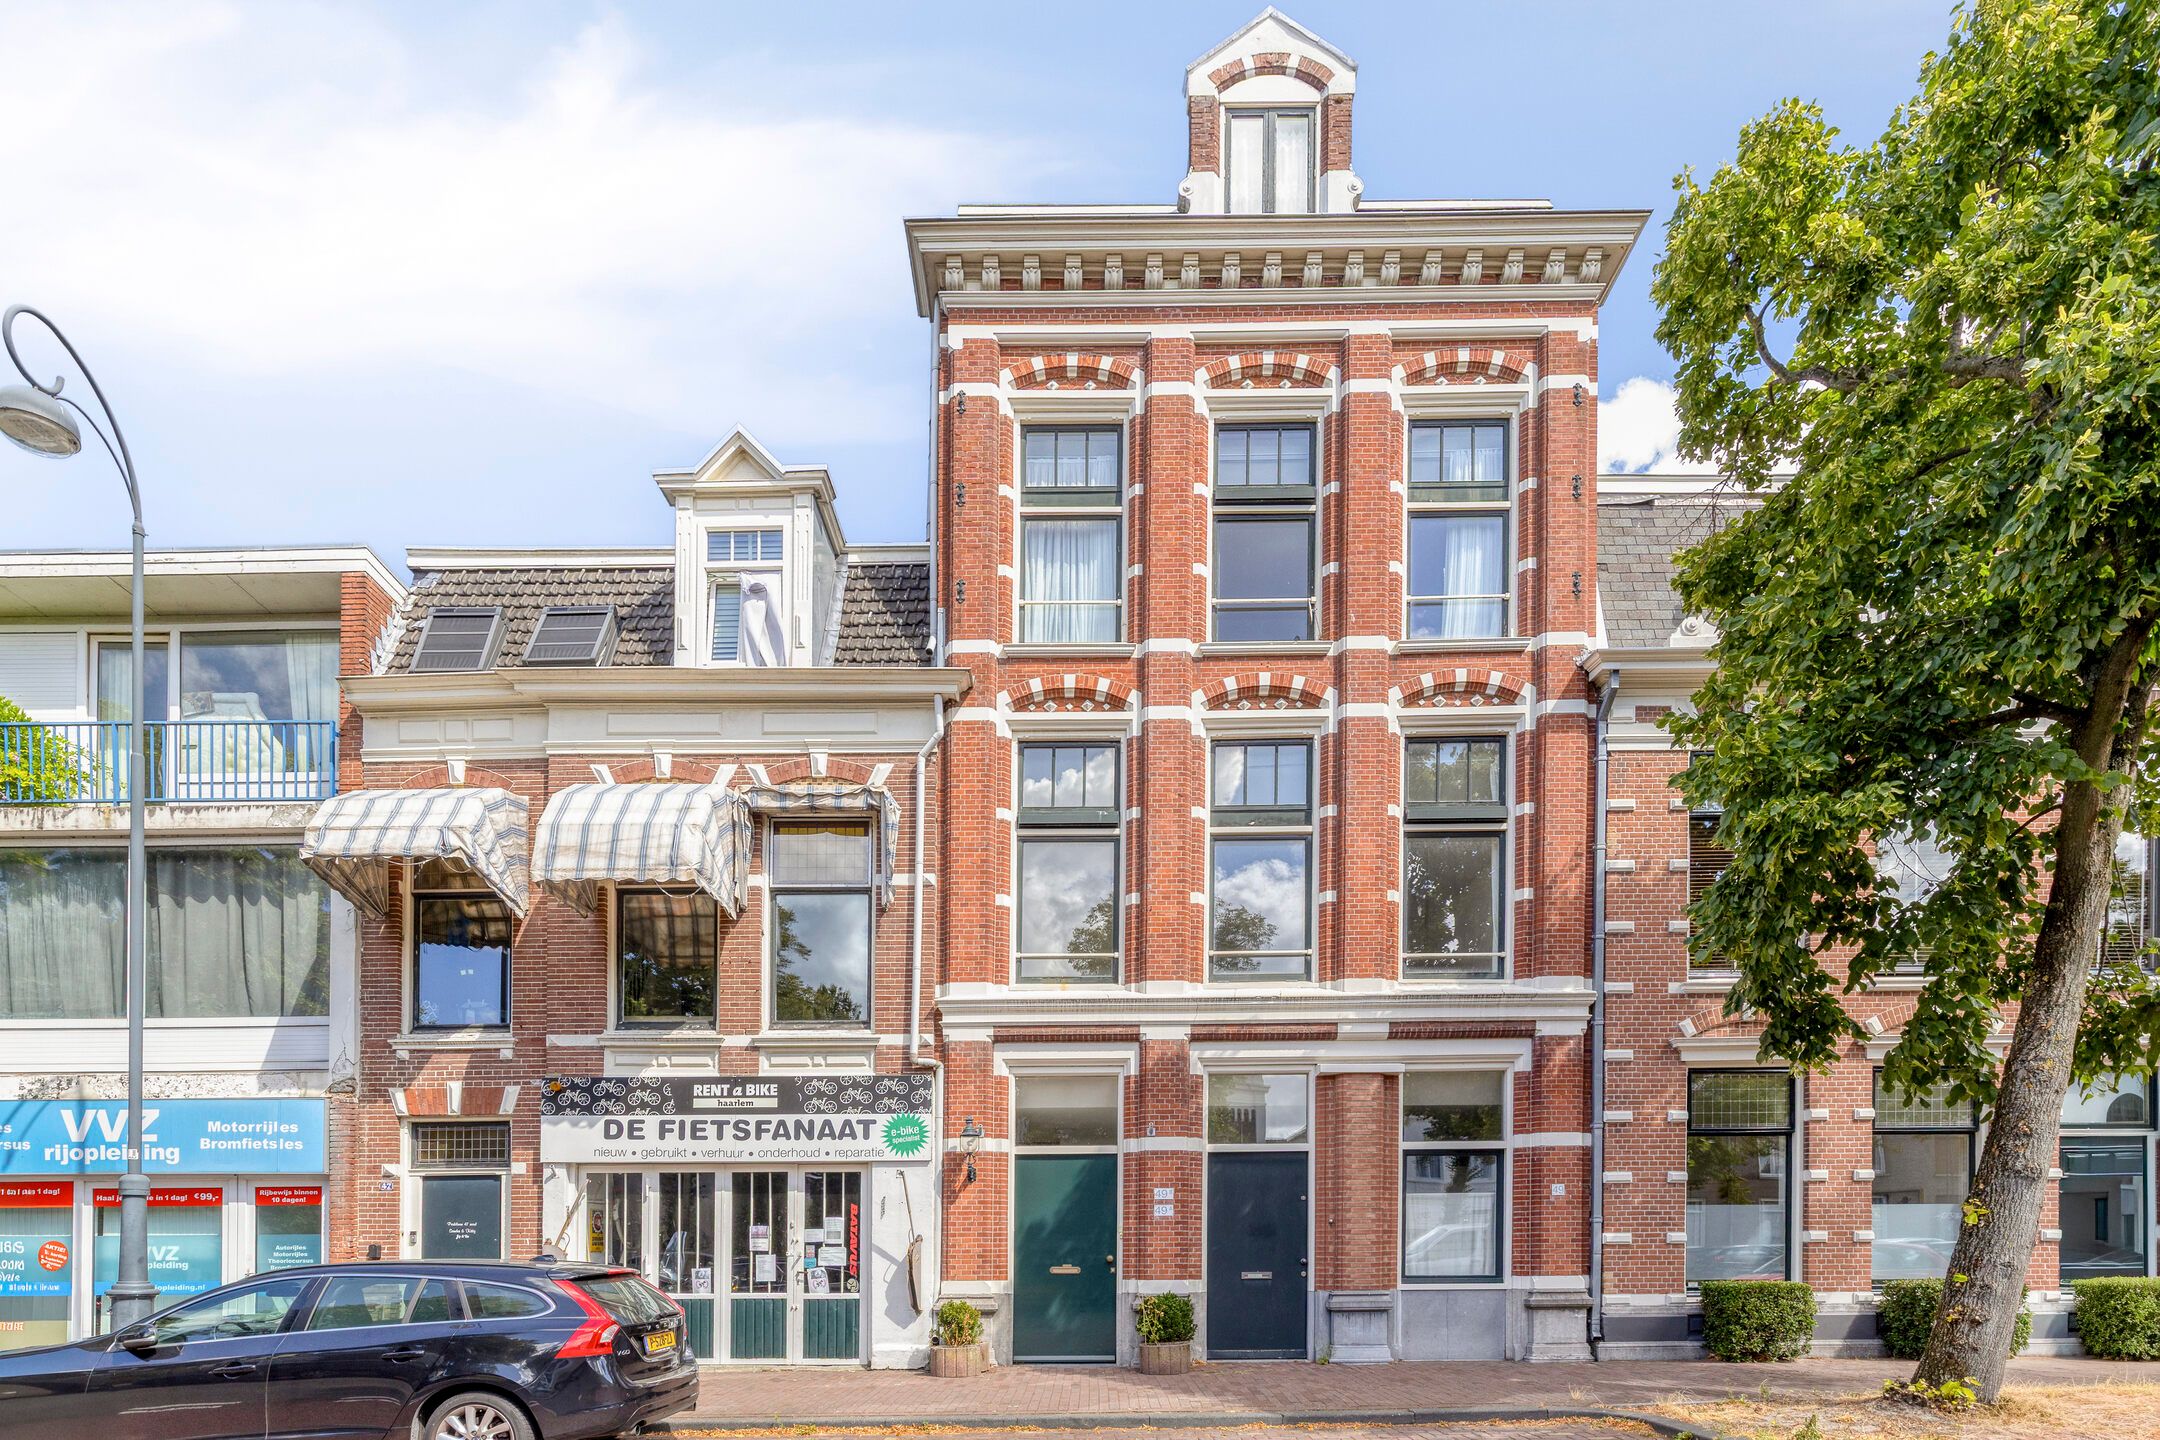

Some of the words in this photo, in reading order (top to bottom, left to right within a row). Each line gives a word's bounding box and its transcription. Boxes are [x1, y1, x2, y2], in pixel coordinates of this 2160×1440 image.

[693, 1084, 730, 1096] RENT
[732, 1086, 743, 1096] a
[745, 1083, 778, 1096] BIKE
[60, 1109, 160, 1143] VVZ
[207, 1121, 299, 1135] Motorrijles
[603, 1119, 646, 1141] DE
[658, 1118, 877, 1141] FIETSFANAAT
[891, 1126, 920, 1136] e-bike
[200, 1138, 304, 1150] Bromfietsles
[892, 1135, 921, 1144] specialist
[44, 1144, 180, 1165] rijopleiing
[593, 1147, 627, 1158] nieuw
[641, 1147, 687, 1160] gebruikt
[701, 1147, 744, 1158] verhuur
[758, 1148, 821, 1158] onderhoud
[834, 1147, 885, 1159] reparatie
[849, 1203, 858, 1276] BATAVUS
[147, 1246, 180, 1261] VZ
[147, 1261, 189, 1270] pleiding
